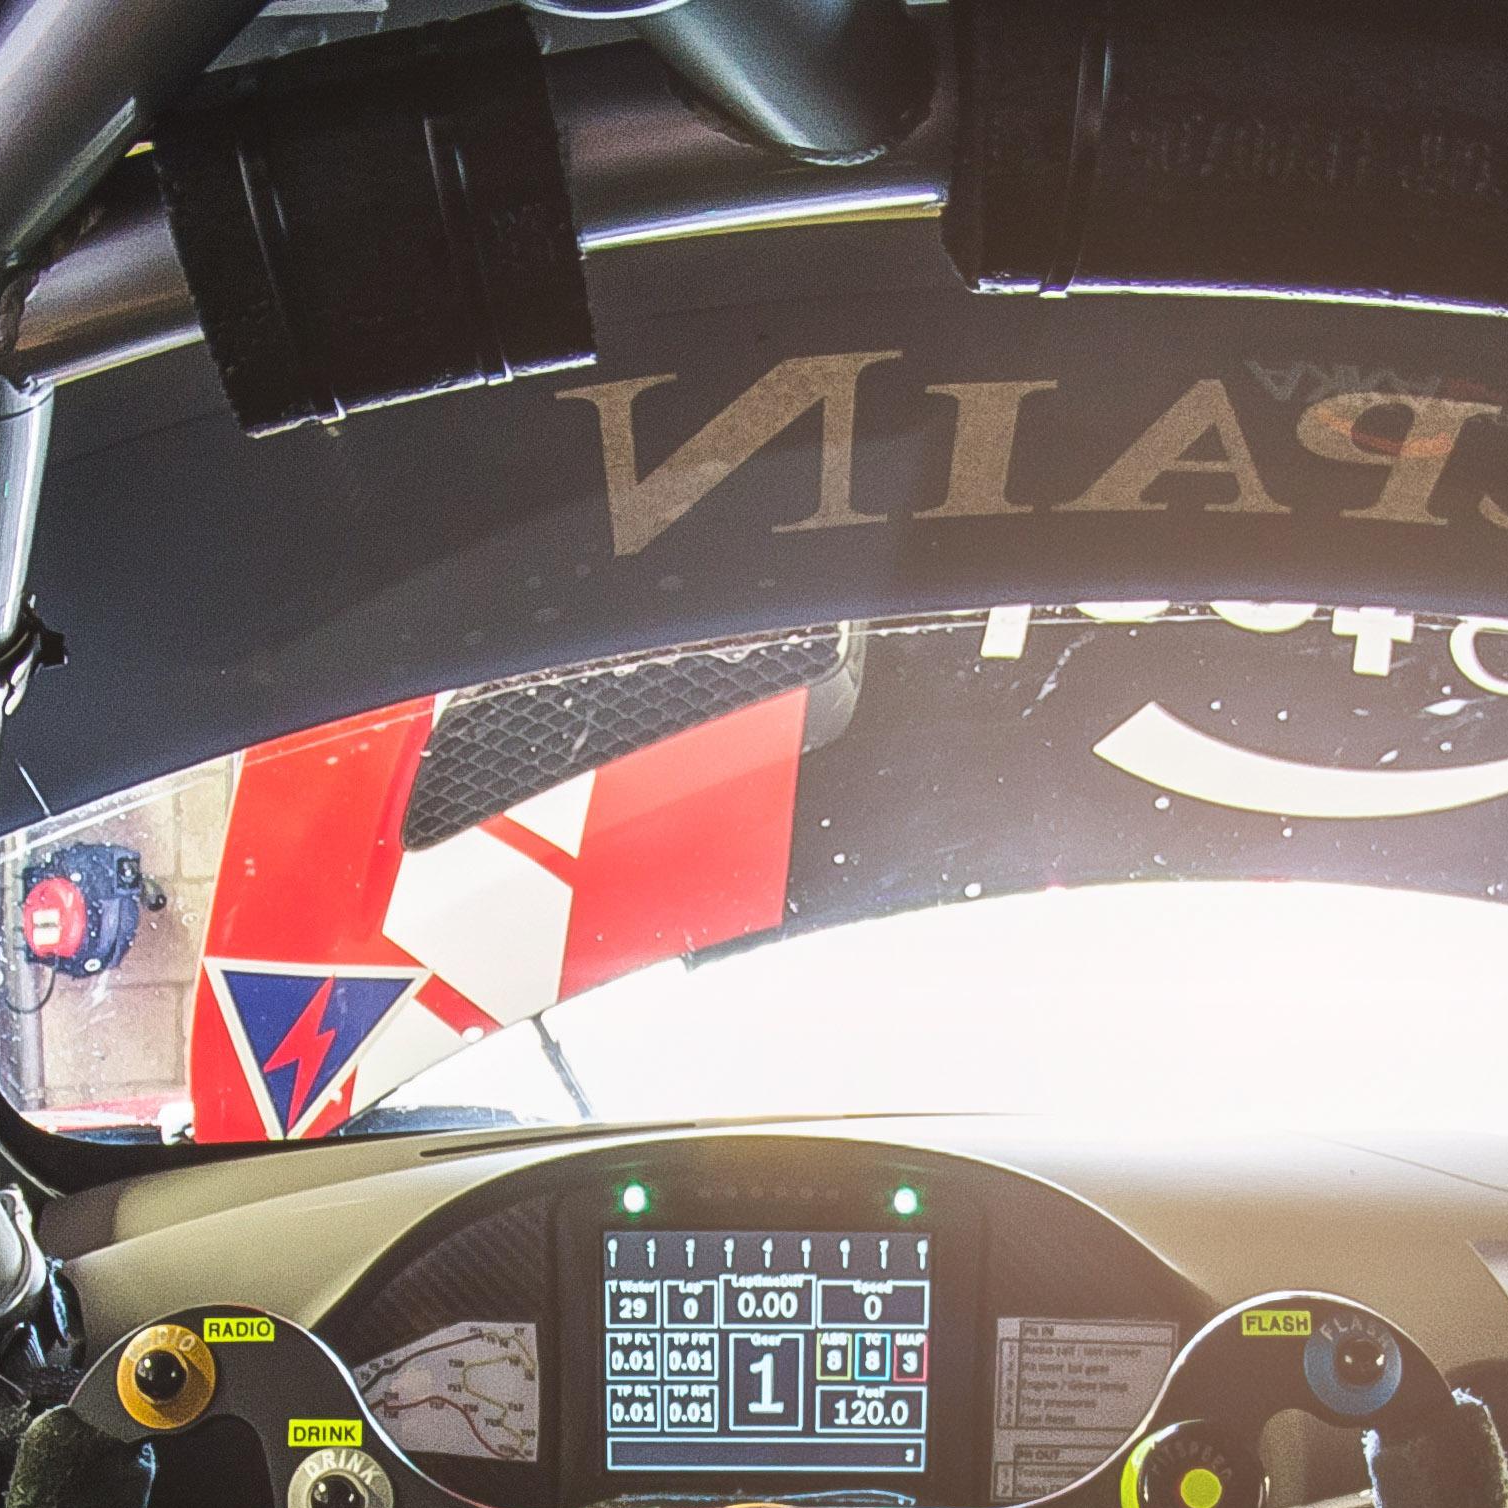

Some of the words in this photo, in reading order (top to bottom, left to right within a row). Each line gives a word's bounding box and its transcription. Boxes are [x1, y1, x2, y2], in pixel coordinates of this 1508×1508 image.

[619, 1298, 647, 1319] 29
[683, 1297, 698, 1319] 0
[737, 1291, 798, 1319] 0.00
[863, 1295, 882, 1321] 0
[208, 1321, 271, 1338] RADIO
[1246, 1316, 1309, 1333] FLASH
[611, 1350, 655, 1372] 0.01
[668, 1350, 713, 1372] 0.01
[902, 1351, 918, 1373] 3
[748, 1352, 784, 1414] 1
[612, 1402, 655, 1423] 0.01
[669, 1402, 713, 1423] 0.01
[833, 1398, 909, 1426] 120.0
[292, 1425, 357, 1443] DRINK
[303, 1448, 379, 1487] DRINK
